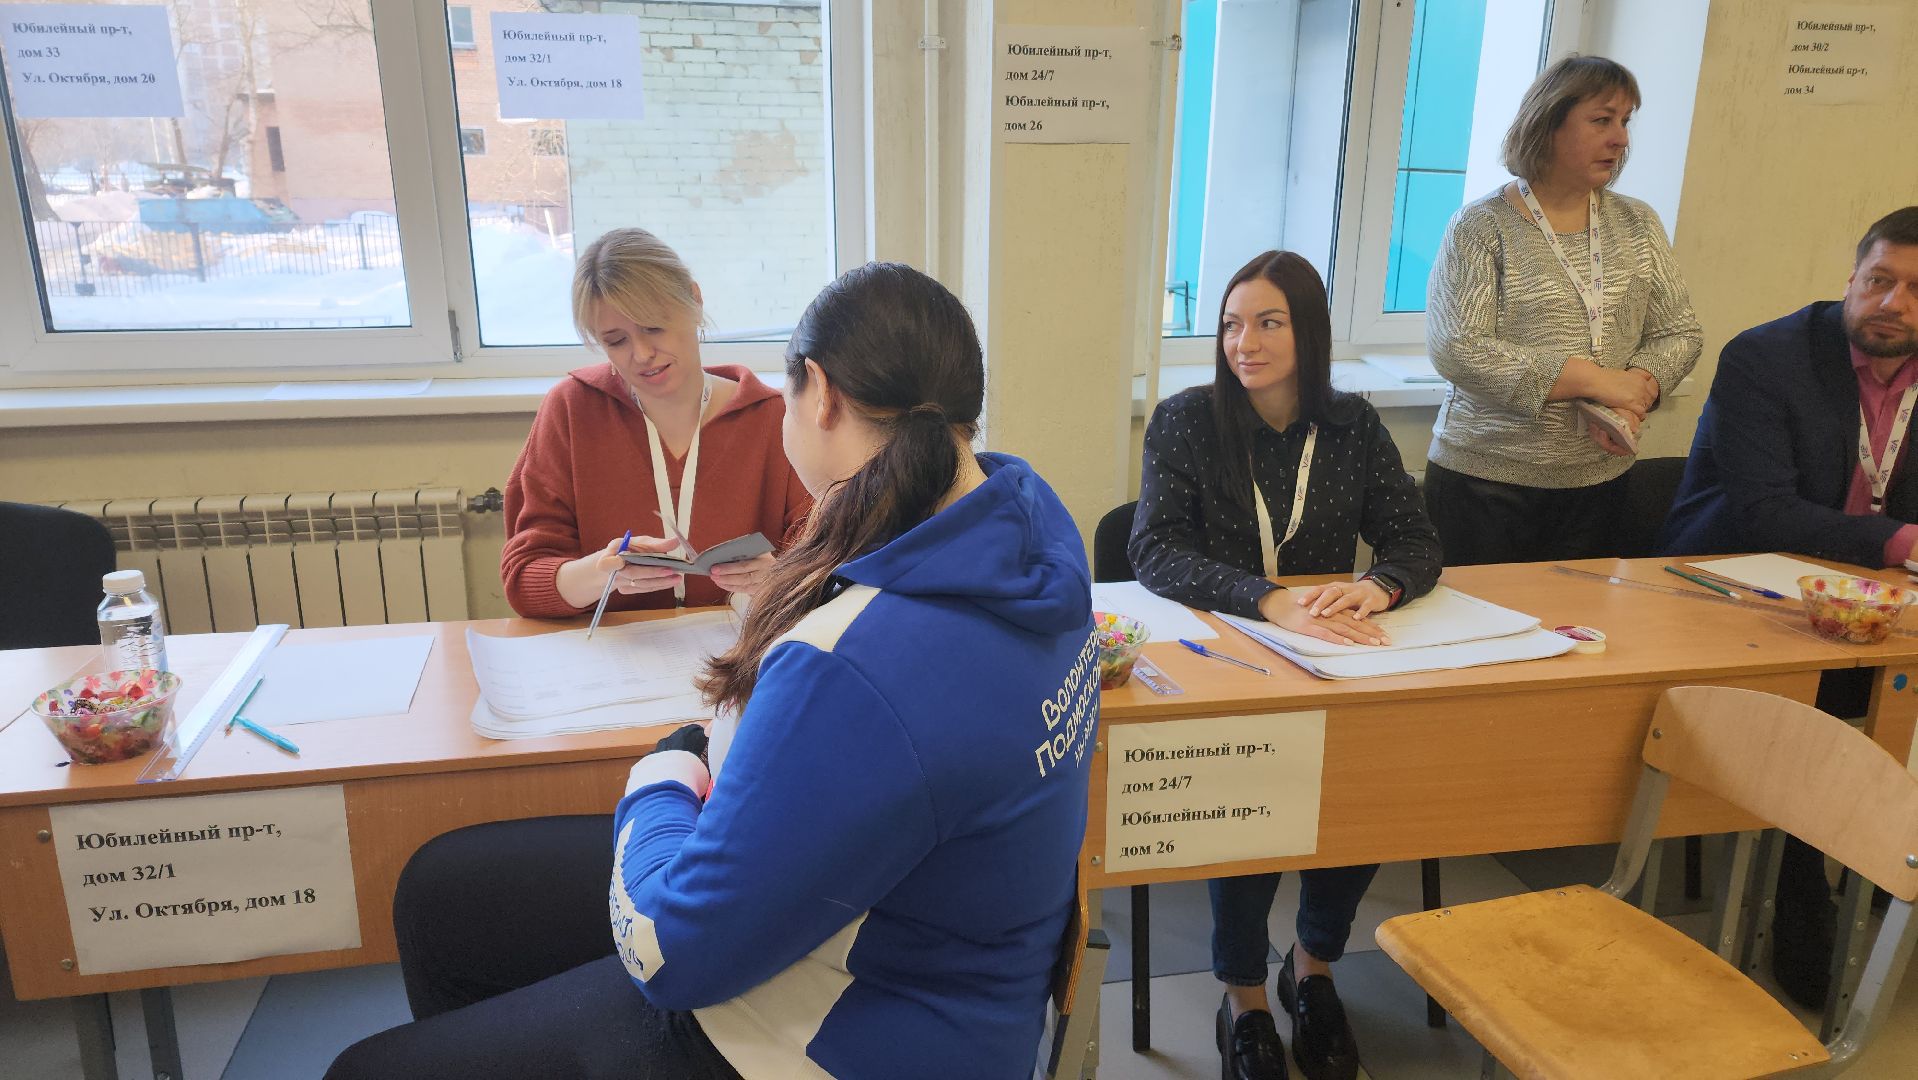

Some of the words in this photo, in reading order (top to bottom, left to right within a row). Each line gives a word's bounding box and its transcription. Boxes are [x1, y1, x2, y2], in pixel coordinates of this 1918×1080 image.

[12, 22, 96, 34] Юбилейный
[100, 26, 132, 36] пр-т,
[1797, 20, 1853, 31] Юбилейный
[1855, 23, 1876, 34] пр-т,
[502, 30, 575, 42] Юбилейный
[579, 34, 607, 44] пр-т,
[17, 48, 43, 58] дом
[45, 47, 60, 58] 33
[1007, 43, 1081, 57] Юбилейный
[1084, 49, 1112, 60] пр-т,
[1791, 43, 1809, 52] дом
[1811, 42, 1830, 52] 30/2
[504, 55, 526, 63] дом
[529, 53, 552, 63] 32/1
[1005, 71, 1028, 81] дом
[1031, 69, 1055, 81] 24/7
[1788, 64, 1845, 75] Юбилейный
[1846, 67, 1868, 77] пр-т,
[22, 72, 45, 84] Ул.
[48, 72, 111, 86] Октября,
[114, 75, 138, 84] дом
[141, 73, 156, 84] 20
[507, 77, 527, 87] Ул.
[530, 77, 584, 90] Октября,
[585, 80, 607, 89] дом
[610, 79, 622, 88] 18
[1784, 86, 1802, 95] дом
[1804, 85, 1815, 94] 34
[1005, 95, 1078, 108] Юбилейный
[1081, 99, 1110, 110] пр-т,
[1004, 121, 1027, 132] дом
[1029, 120, 1043, 131] 26
[1123, 743, 1231, 764] Юбилейный
[1236, 742, 1276, 758] пр-т,
[1121, 781, 1154, 794] дом
[1158, 775, 1192, 791] 24/7
[1121, 806, 1226, 827] Юбилейный
[1231, 804, 1271, 820] пр-т,
[75, 824, 220, 851] Юбилейный
[227, 821, 282, 842] пр-т,
[1120, 843, 1151, 858] дом
[1156, 840, 1175, 855] 26
[83, 871, 126, 887] дом
[132, 862, 176, 882] 32/1
[88, 906, 129, 923] Ул.
[135, 898, 240, 920] Октября,
[245, 893, 286, 911] дом
[292, 887, 316, 905] 18
